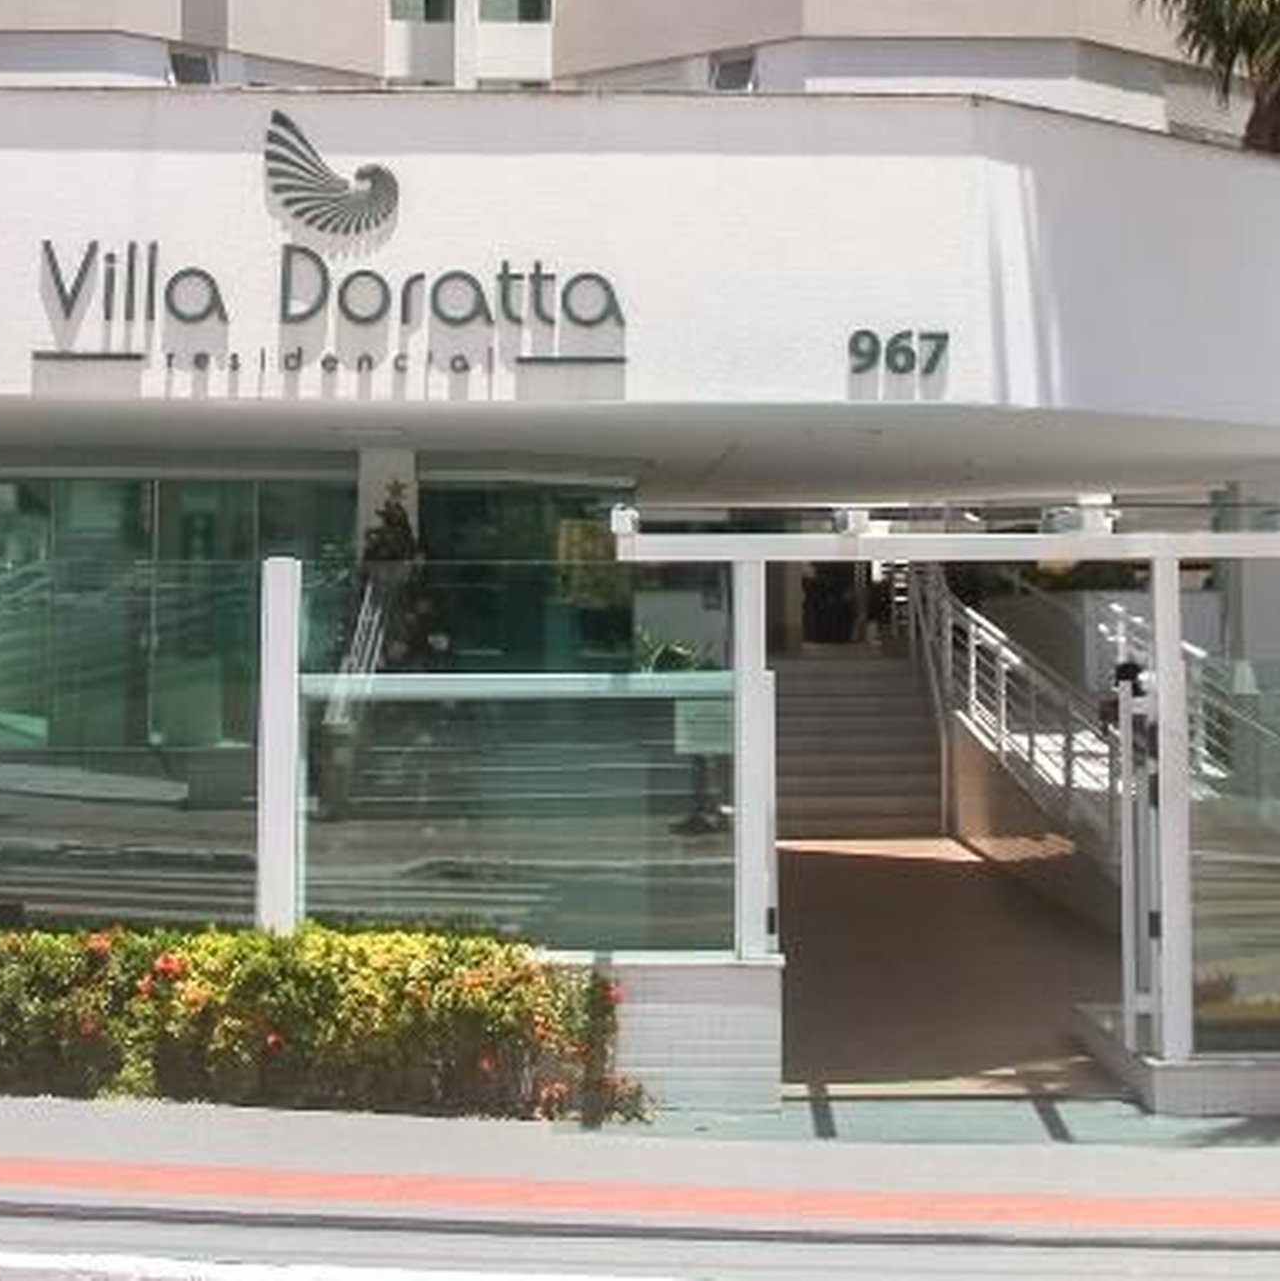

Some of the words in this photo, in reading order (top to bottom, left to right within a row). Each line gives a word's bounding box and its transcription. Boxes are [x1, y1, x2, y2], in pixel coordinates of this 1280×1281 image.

[41, 239, 229, 325] Villa
[280, 242, 626, 328] Doratta
[166, 347, 494, 373] residencial
[847, 328, 949, 375] 967
